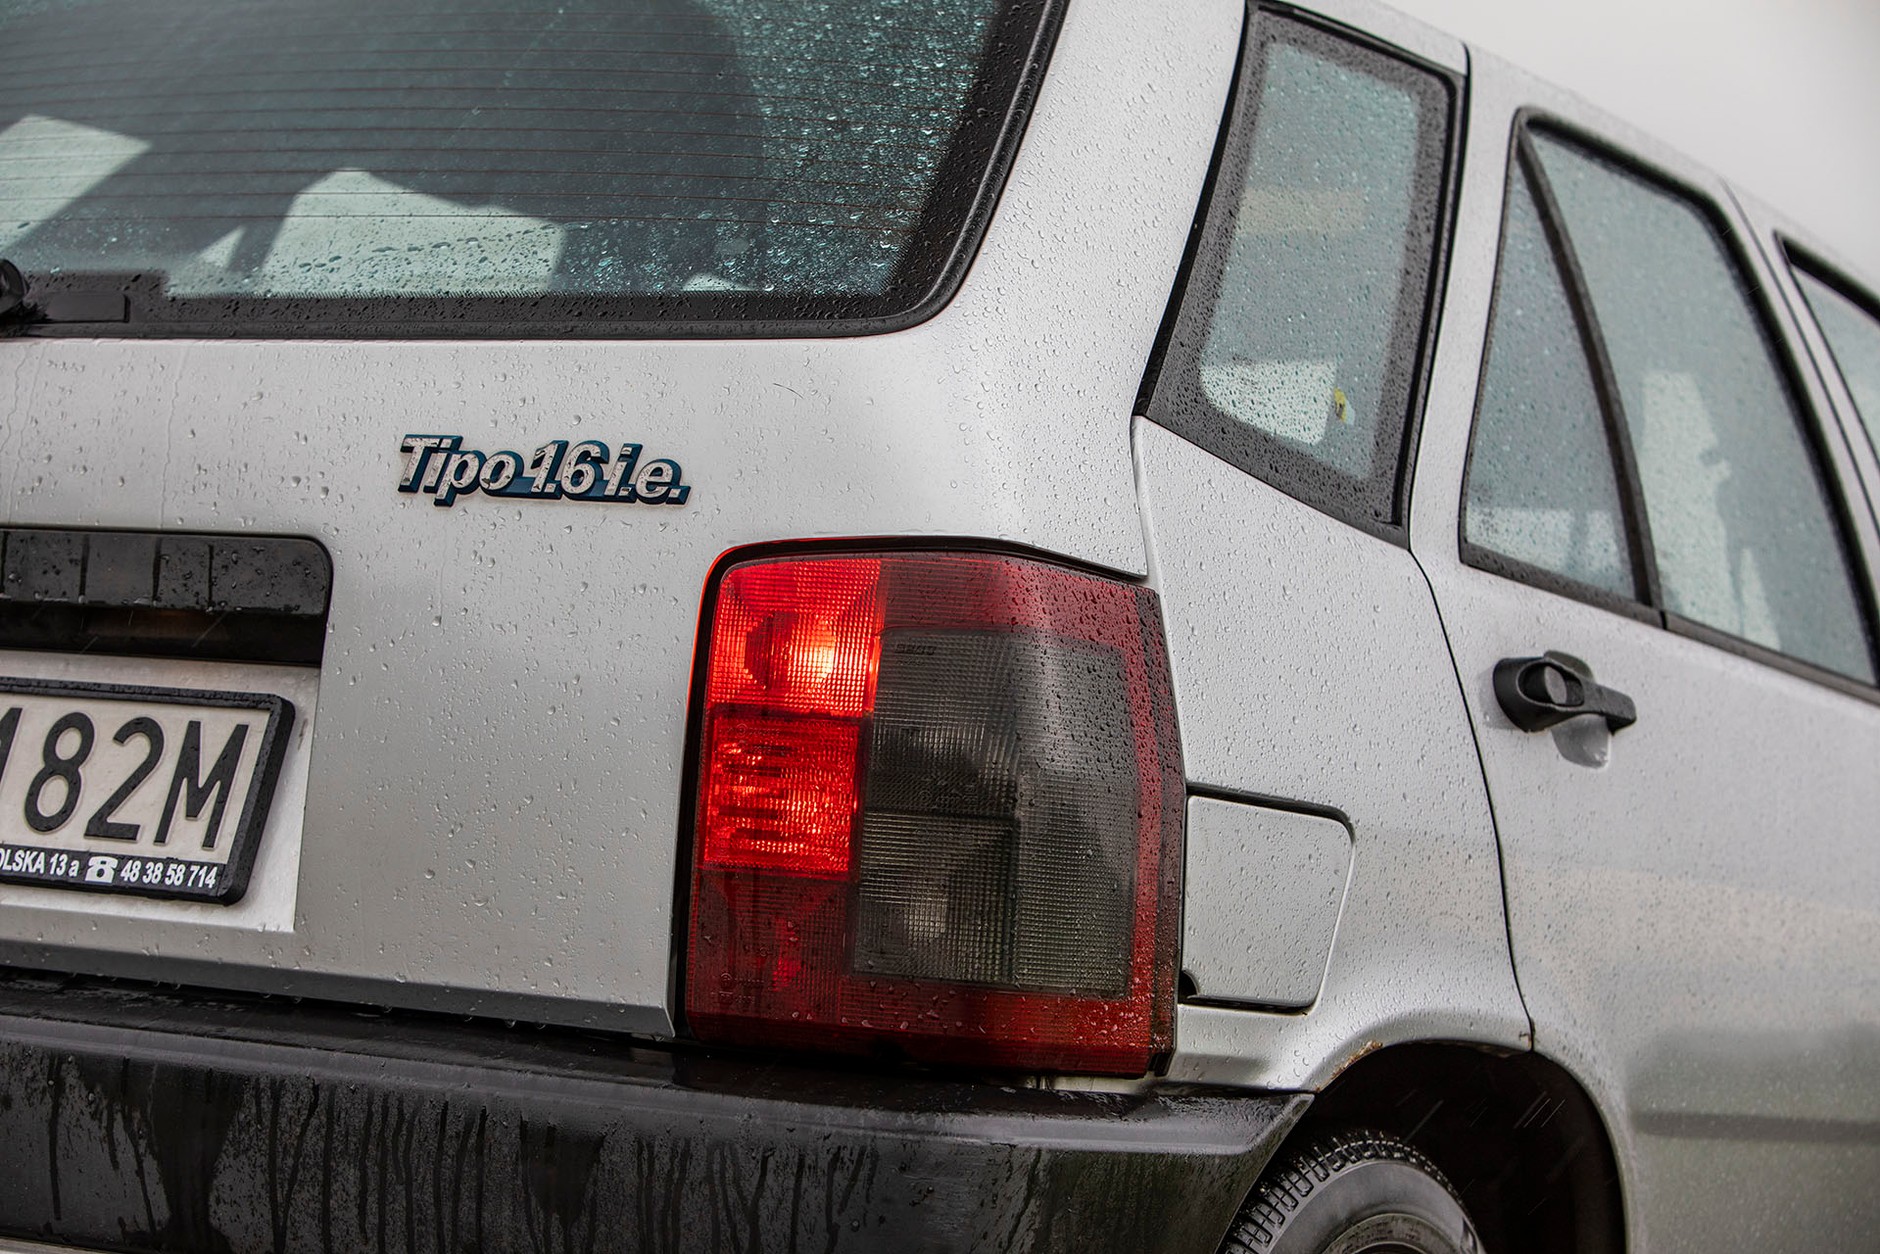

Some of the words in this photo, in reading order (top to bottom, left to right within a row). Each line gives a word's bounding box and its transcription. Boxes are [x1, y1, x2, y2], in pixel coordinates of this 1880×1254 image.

[398, 434, 524, 507] Tipo
[50, 853, 69, 876] 13
[68, 859, 80, 877] a
[120, 860, 140, 882] 48
[143, 861, 163, 884] 38
[165, 863, 186, 886] 58
[187, 865, 218, 889] 714
